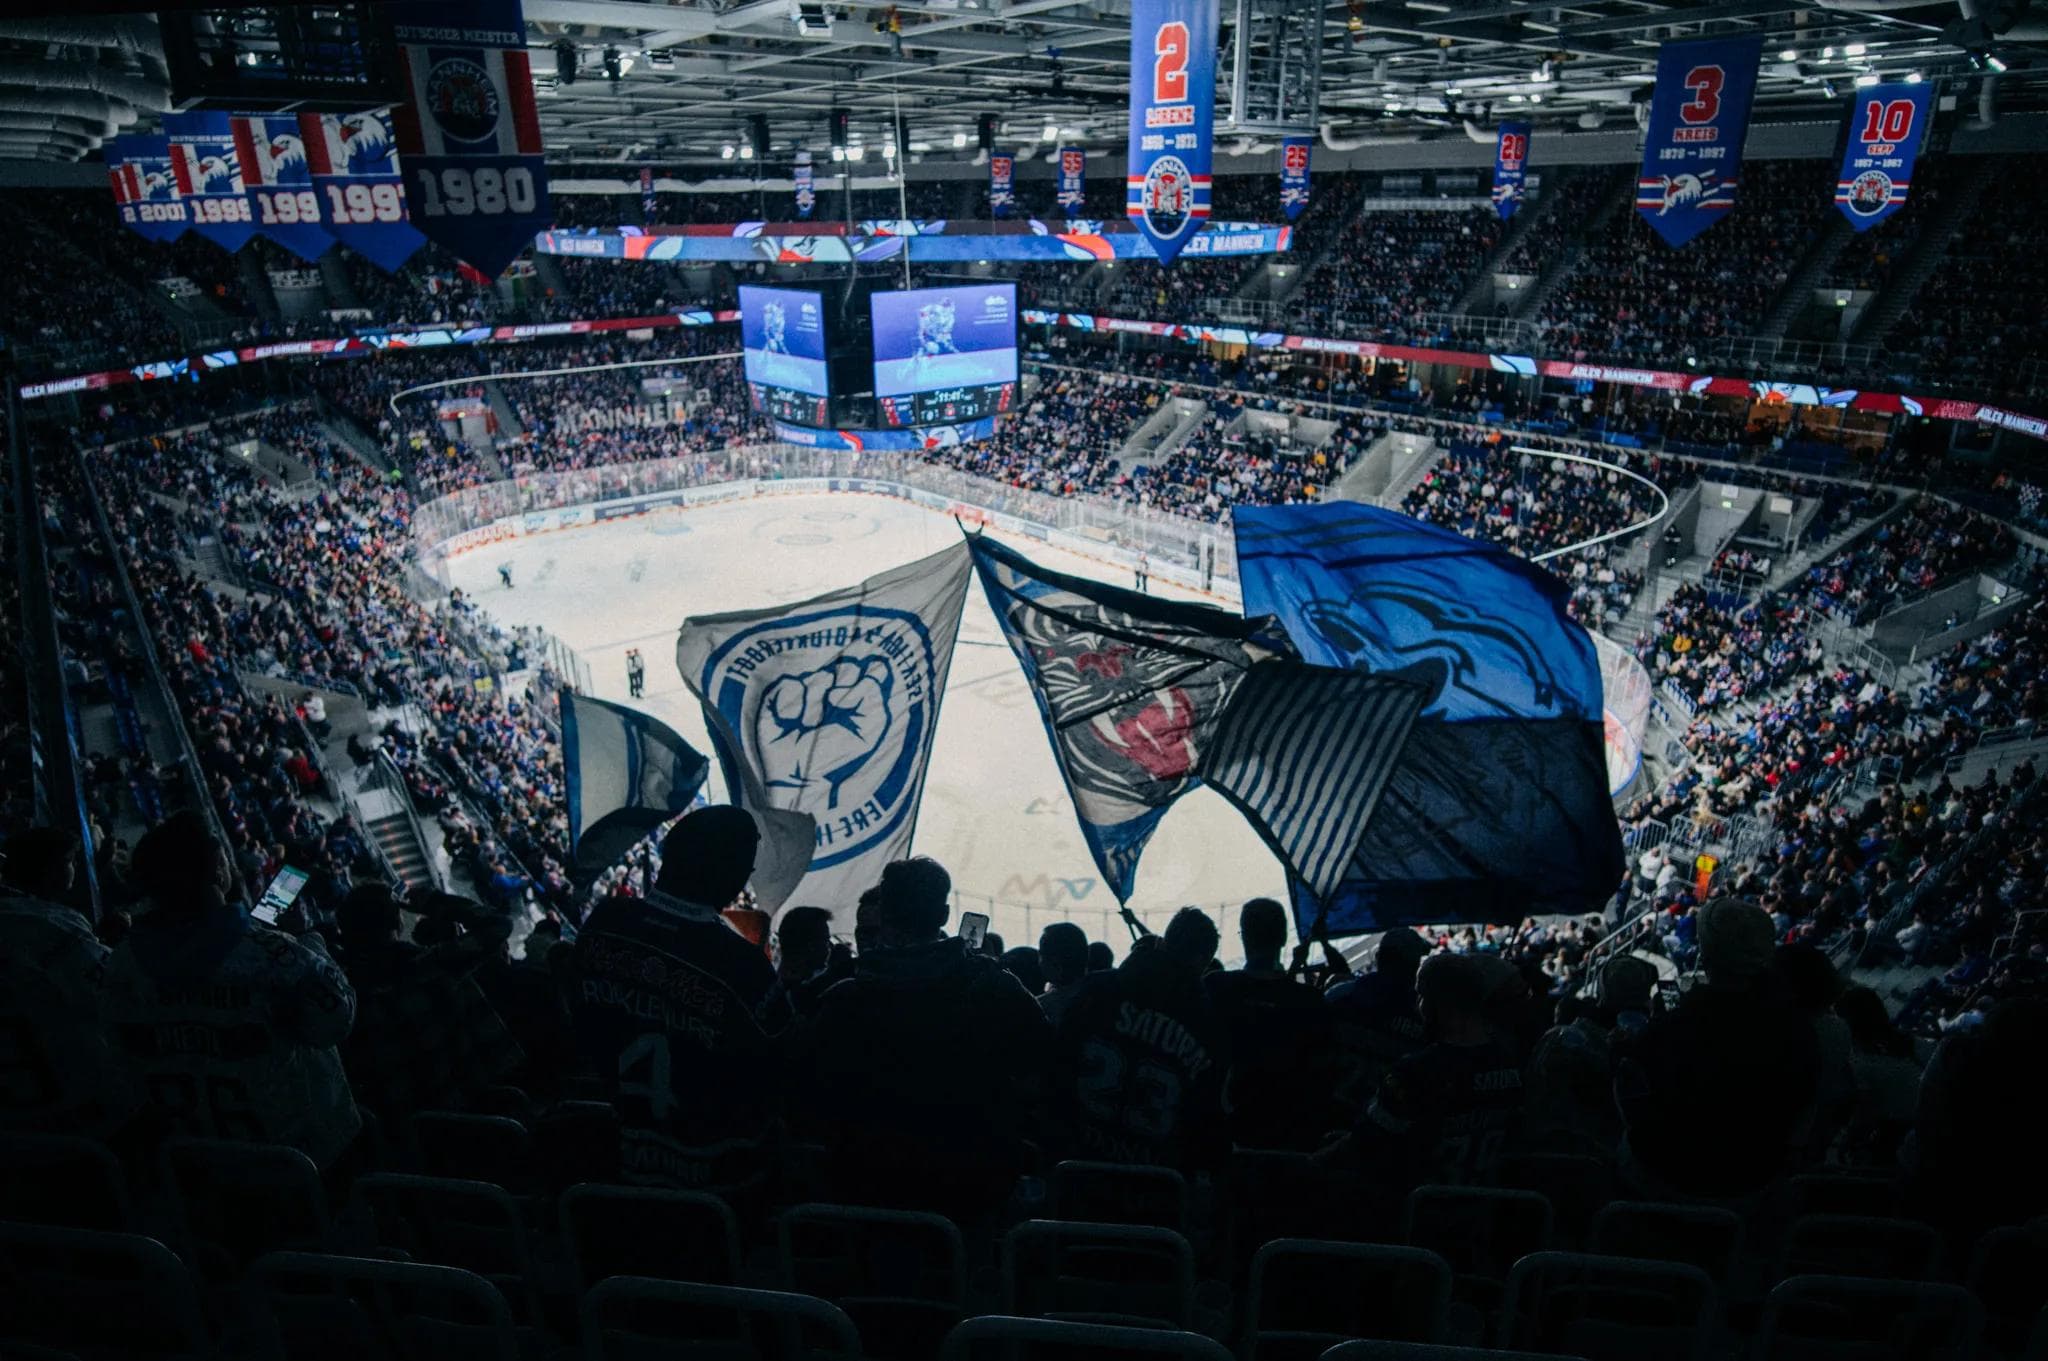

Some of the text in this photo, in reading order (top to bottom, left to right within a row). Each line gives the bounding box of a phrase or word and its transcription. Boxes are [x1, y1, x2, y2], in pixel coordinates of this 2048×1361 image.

[1154, 21, 1190, 104] 2
[1680, 64, 1726, 125] 3
[1672, 127, 1719, 143] KREIS
[1861, 99, 1915, 143] 10
[417, 167, 536, 216] 1980
[140, 204, 186, 222] 2001
[258, 192, 321, 224] 199
[1182, 235, 1209, 254] LER
[1975, 406, 2004, 424] ADLER
[2001, 413, 2047, 437] MANNHEIM
